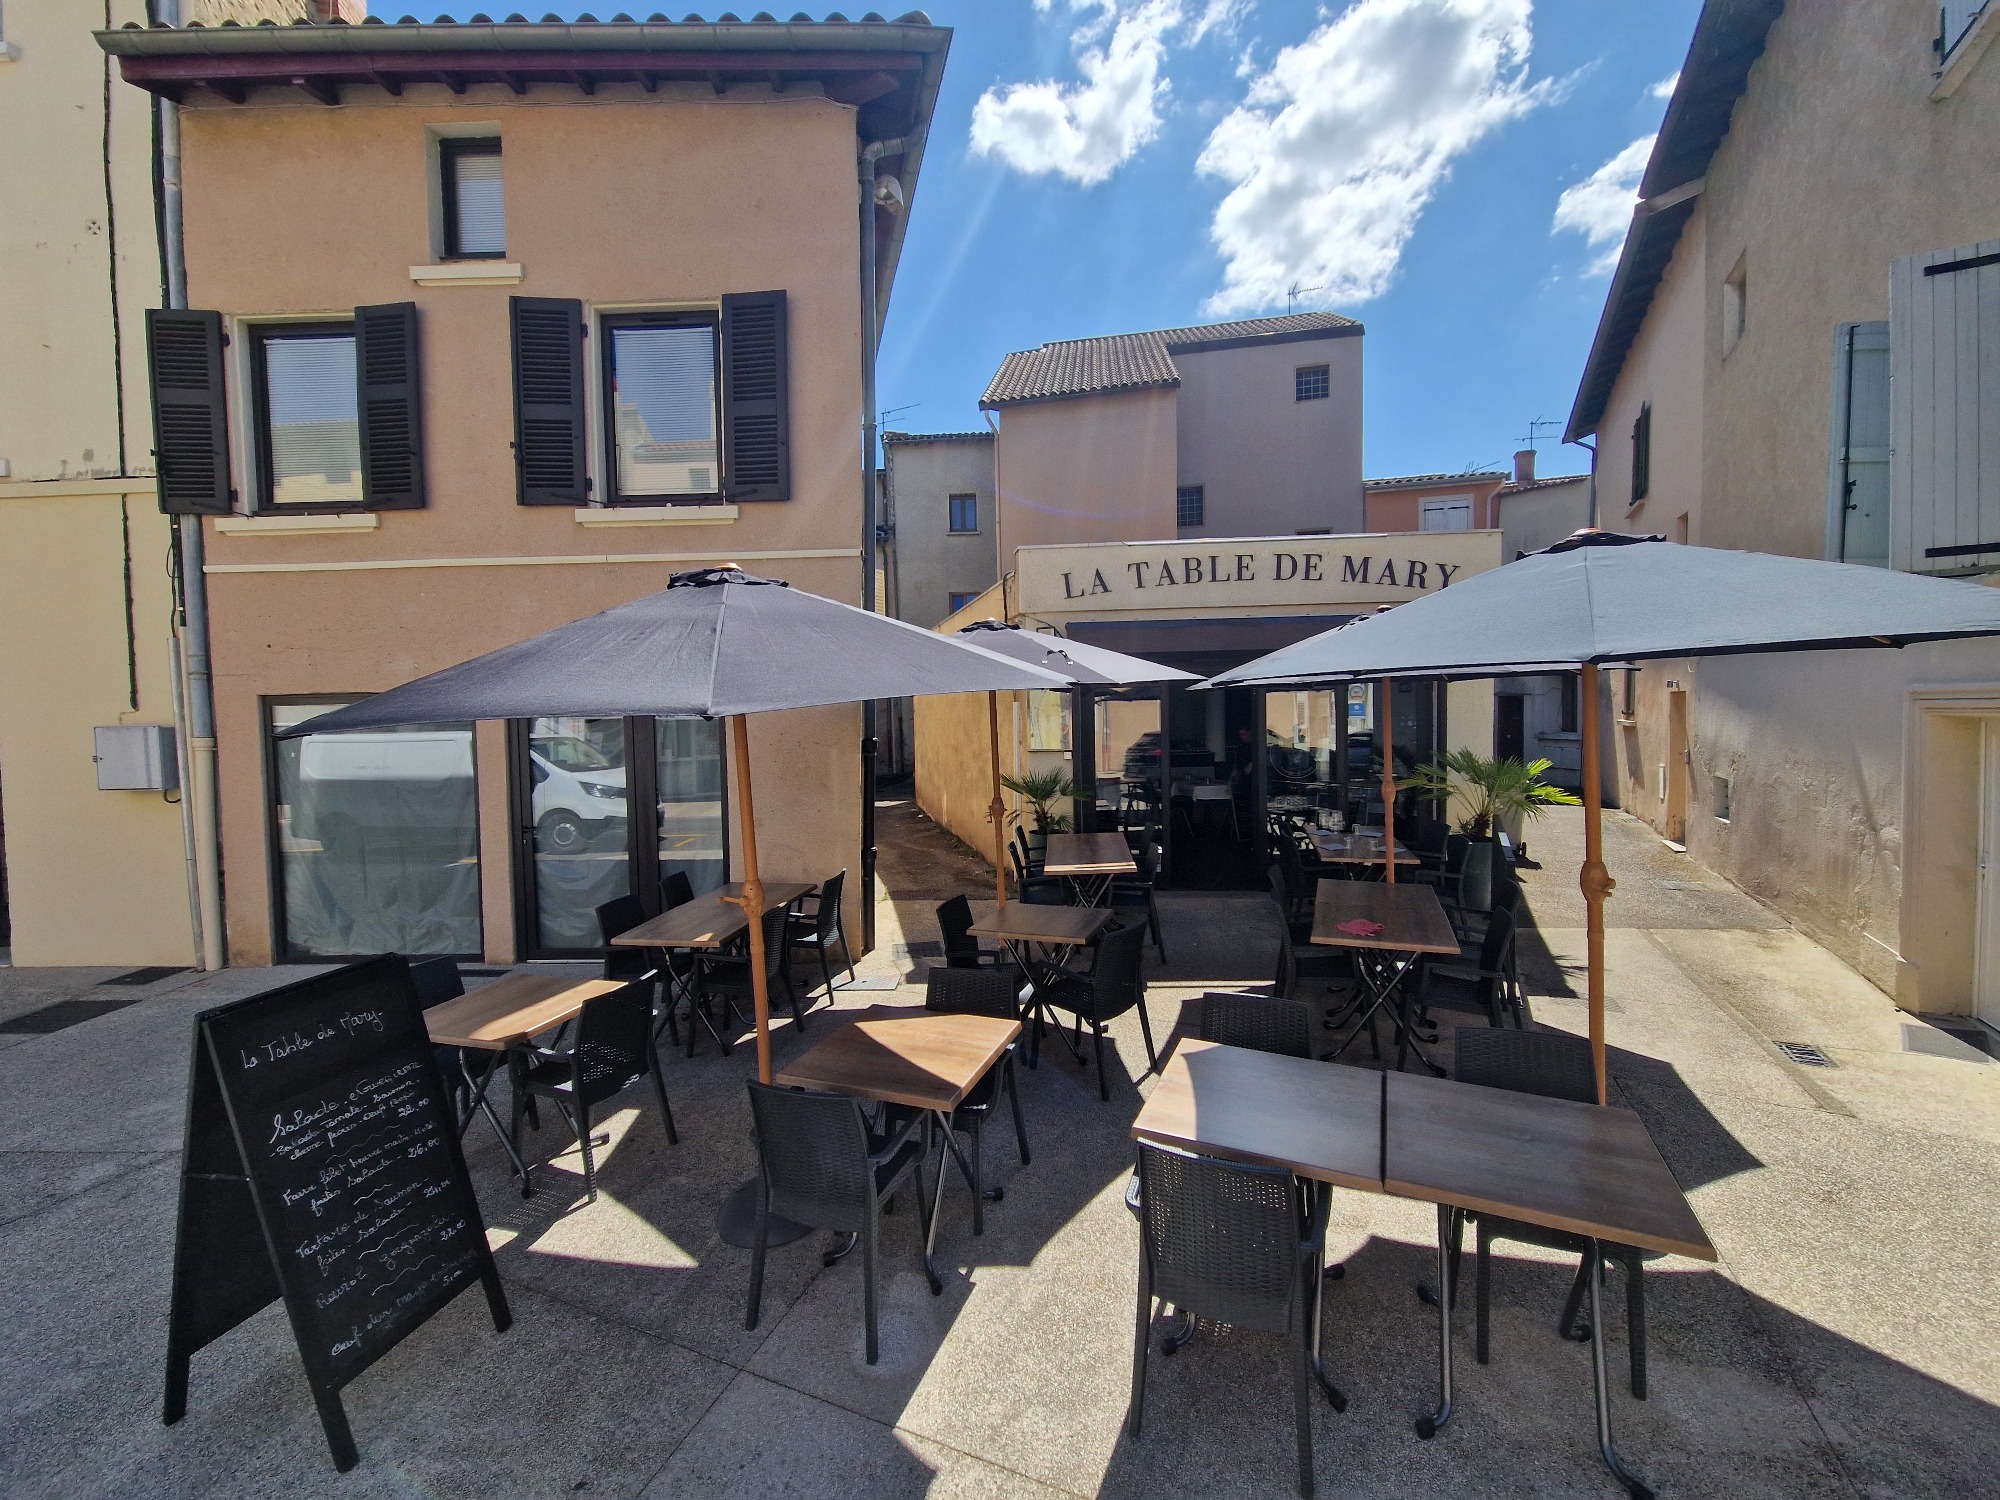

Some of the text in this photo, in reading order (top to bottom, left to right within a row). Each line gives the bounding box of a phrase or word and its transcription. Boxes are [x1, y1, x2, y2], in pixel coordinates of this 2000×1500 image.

[1061, 553, 1462, 600] LA TABLE DE MARY
[261, 1032, 313, 1061] Table
[317, 1024, 336, 1040] de
[269, 1100, 339, 1144] Salade
